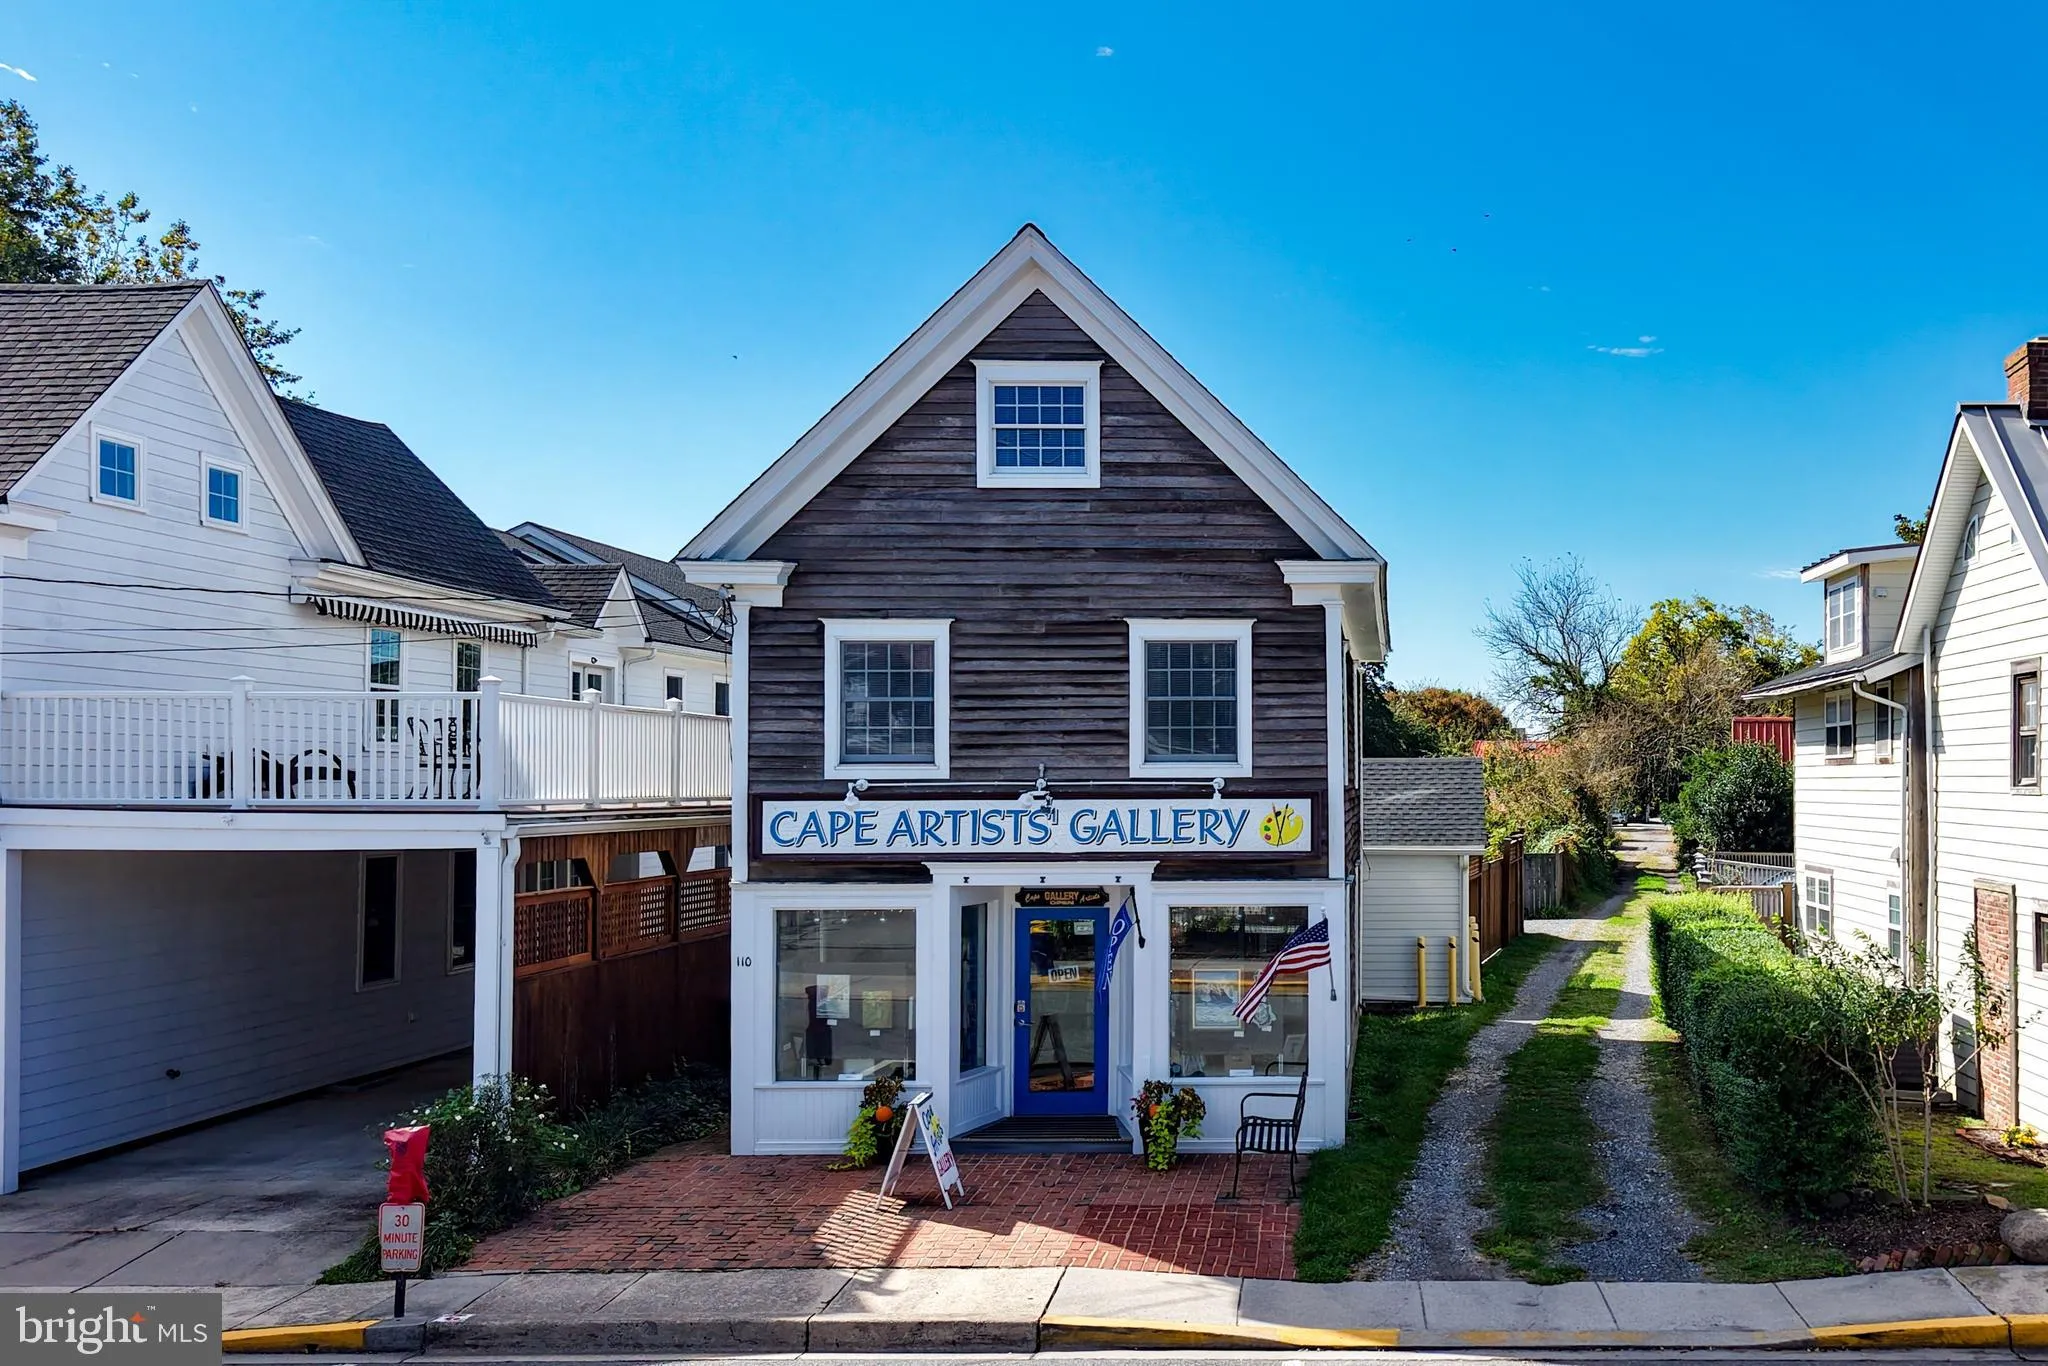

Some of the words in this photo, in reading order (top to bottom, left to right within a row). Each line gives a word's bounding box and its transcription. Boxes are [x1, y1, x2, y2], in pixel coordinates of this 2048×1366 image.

[769, 810, 878, 847] CAPE
[1069, 808, 1250, 847] GALLERY
[1045, 891, 1079, 900] GALLERY
[736, 956, 752, 967] 110
[1050, 967, 1078, 981] OPEN
[394, 1215, 410, 1228] 30
[383, 1232, 418, 1244] MINUTE
[382, 1249, 418, 1260] PARKING
